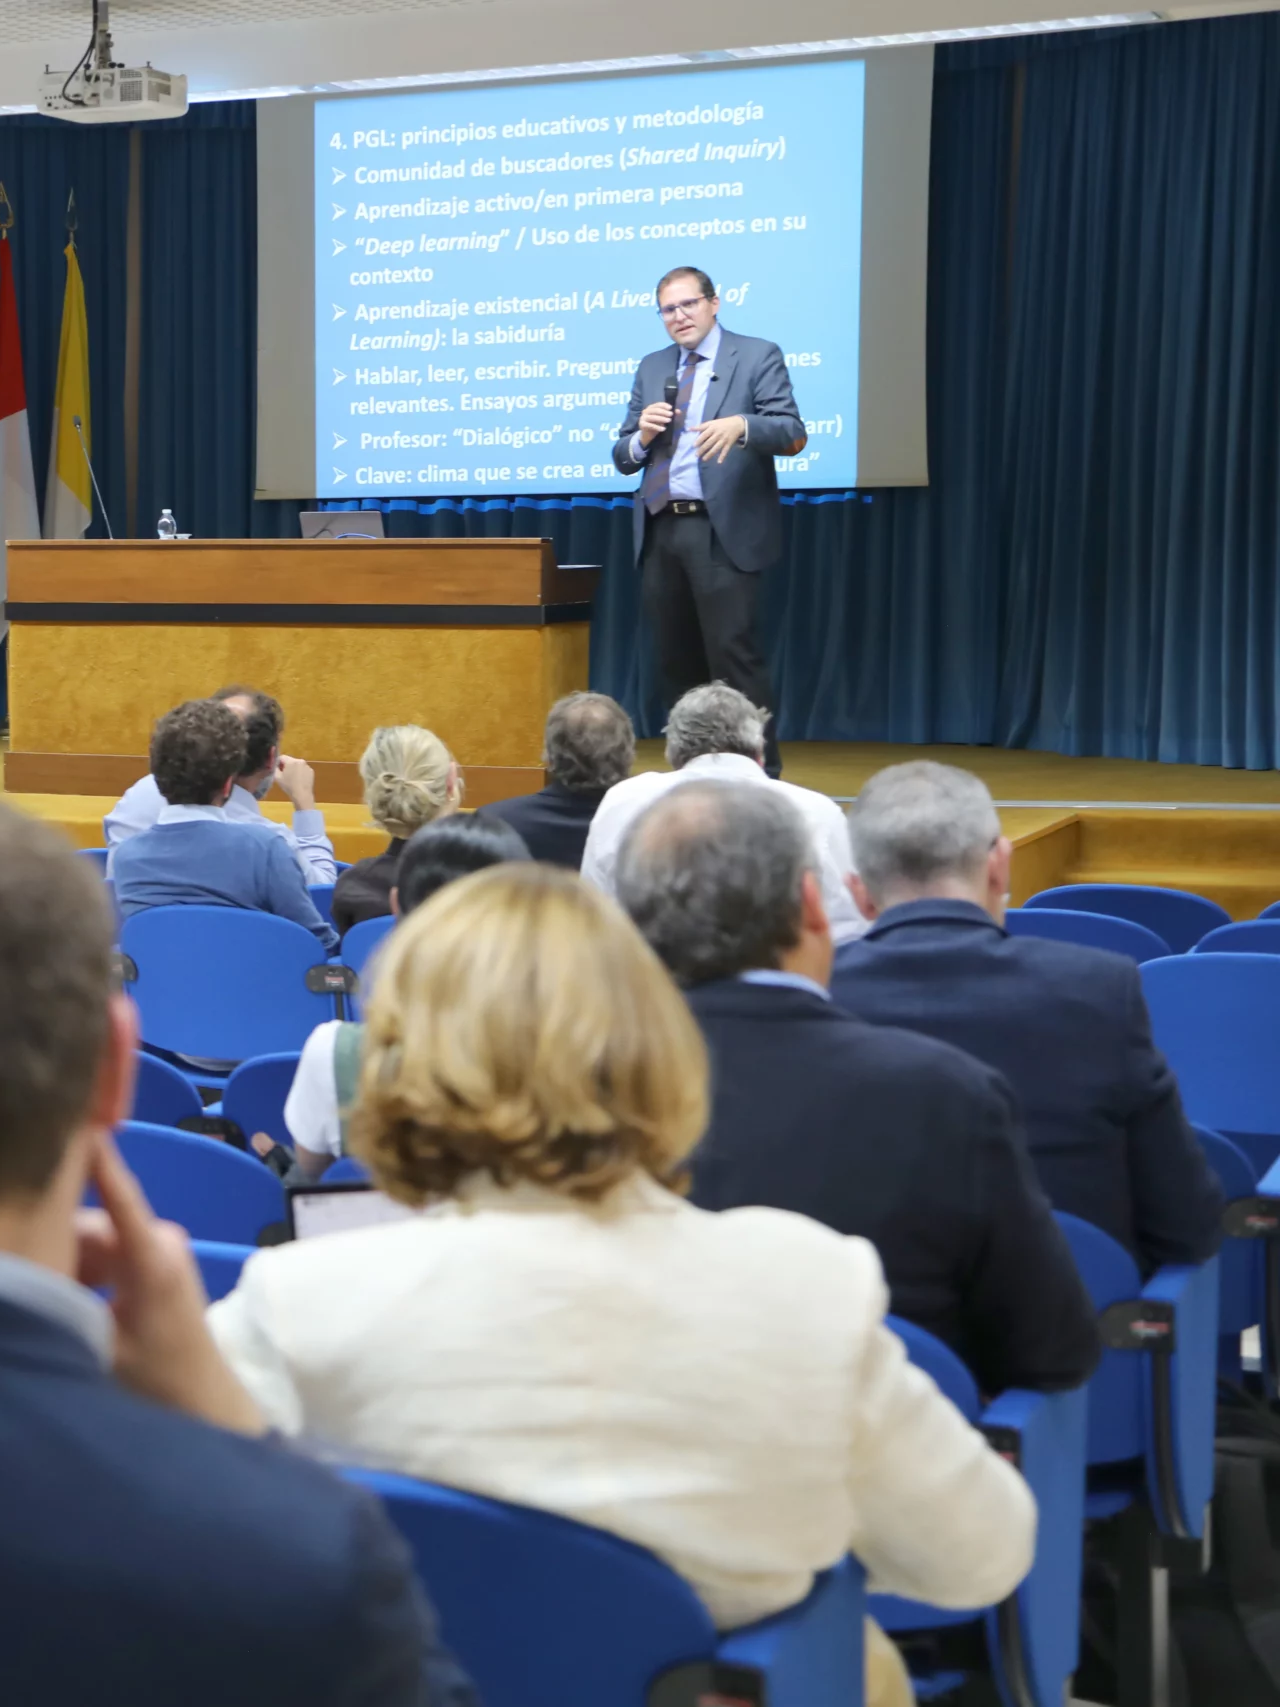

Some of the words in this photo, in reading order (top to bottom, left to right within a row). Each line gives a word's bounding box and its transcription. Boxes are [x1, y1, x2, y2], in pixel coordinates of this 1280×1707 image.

[330, 133, 346, 149] 4.
[354, 130, 395, 148] PGL:
[402, 123, 496, 149] principios
[502, 115, 609, 138] educativos
[615, 116, 627, 134] y
[633, 101, 763, 128] metodología
[355, 159, 465, 184] Comunidad
[470, 158, 495, 176] de
[501, 152, 613, 175] buscadores
[620, 143, 699, 171] (Shared
[704, 136, 785, 163] Inquiry)
[354, 196, 469, 221] Aprendizaje
[475, 189, 568, 213] activo/en
[575, 187, 654, 210] primera
[660, 182, 743, 205] persona
[515, 227, 526, 250] /
[532, 228, 570, 245] Uso
[574, 224, 600, 243] de
[606, 223, 635, 241] los
[640, 218, 745, 240] conceptos
[751, 217, 777, 232] en
[783, 216, 806, 230] su
[350, 266, 433, 285] contexto
[355, 298, 469, 324] Aprendizaje
[474, 292, 577, 315] existencial
[584, 291, 604, 313] (A
[611, 288, 658, 309] Livel
[725, 282, 750, 306] of
[350, 328, 446, 351] Learning):
[452, 328, 469, 345] la
[474, 323, 565, 344] sabiduría
[356, 366, 422, 386] Hablar,
[428, 364, 469, 384] leer,
[475, 360, 550, 380] escribir.
[351, 397, 454, 414] relevantes.
[461, 394, 537, 413] Ensayos
[543, 392, 631, 411] argumen
[361, 431, 446, 449] Profesor:
[569, 429, 593, 442] no
[356, 467, 411, 484] Clave:
[418, 465, 468, 482] clima
[474, 467, 510, 484] que
[517, 466, 537, 479] se
[543, 465, 584, 478] crea
[590, 464, 614, 477] en
